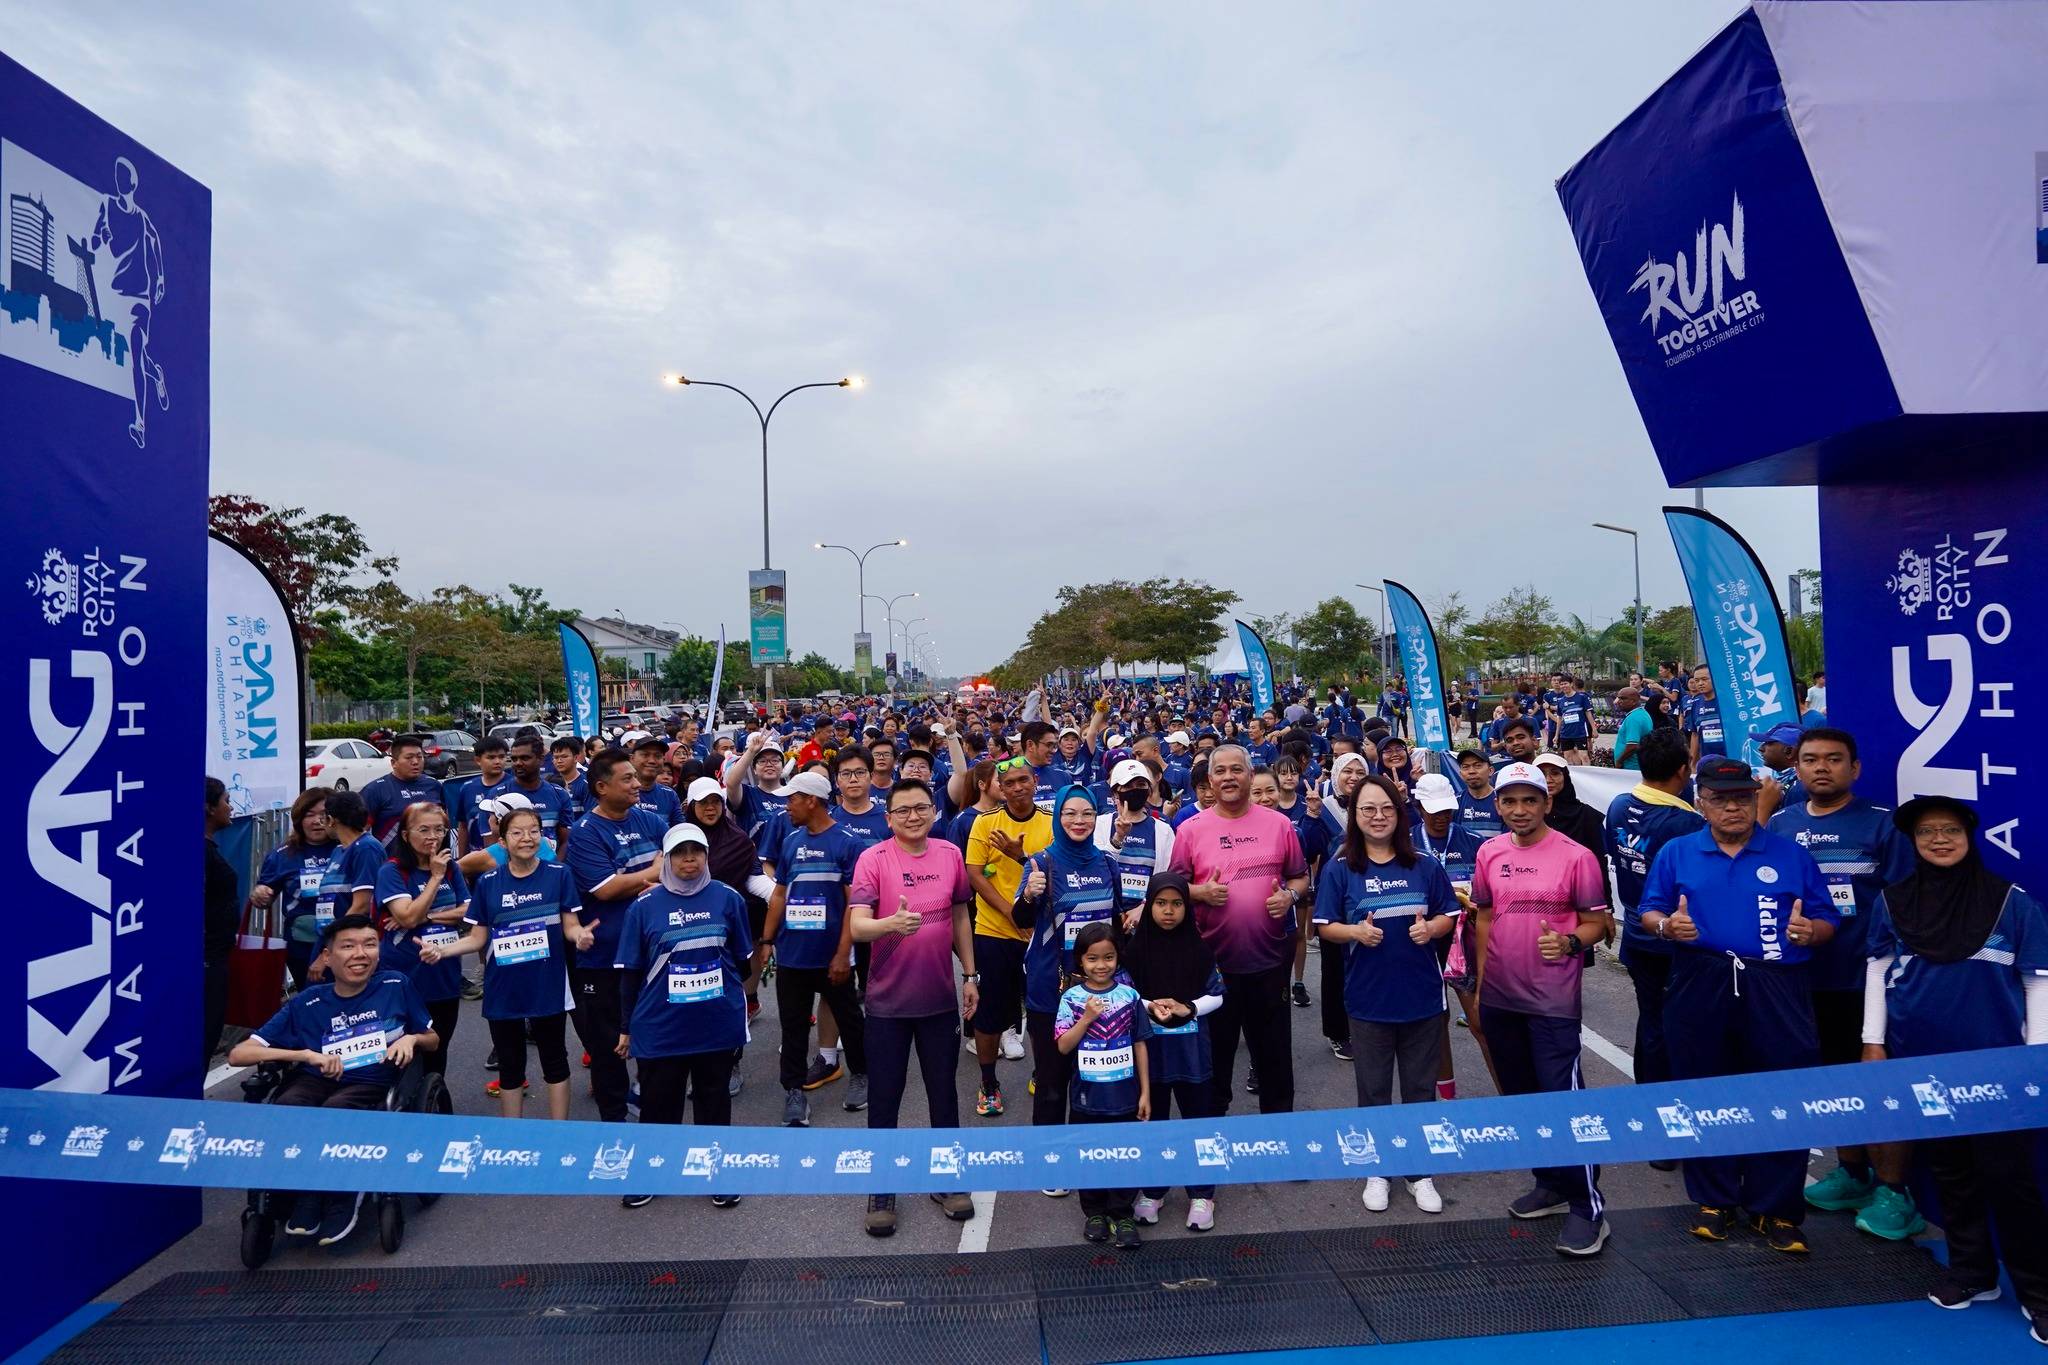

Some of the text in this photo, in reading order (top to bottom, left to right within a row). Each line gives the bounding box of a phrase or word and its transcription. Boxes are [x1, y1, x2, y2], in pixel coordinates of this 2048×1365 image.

[1627, 187, 1745, 336] RUN
[1665, 312, 1765, 368] TOWARDS A SUSTAINABLE CITY
[1935, 533, 1953, 620] ROYAL
[1954, 546, 1971, 608] CITY
[82, 546, 100, 636] ROYAL
[100, 562, 116, 627] CITY
[1973, 528, 2021, 860] ATHON
[114, 554, 148, 1087] MARATHON
[27, 650, 113, 1094] KLANG
[1122, 878, 1147, 887] 10793
[1832, 891, 1849, 900] 46
[788, 909, 823, 917] FR 10042
[1069, 927, 1081, 935] FR
[1758, 895, 1783, 961] MCPF
[498, 936, 544, 951] FR 11225
[673, 975, 719, 988] FR 11199
[346, 1038, 381, 1053] 11228
[1082, 1052, 1131, 1066] FR 10033
[1950, 1083, 1996, 1099] KLANG
[1802, 1097, 1865, 1114] MONZO
[1695, 1108, 1743, 1122] KLANG
[1460, 1126, 1508, 1140] KLANG
[204, 1137, 256, 1151] KLANG
[321, 1143, 388, 1160] MONZO
[1232, 1140, 1278, 1153] KLANG
[481, 1148, 532, 1163] KLANG
[722, 1153, 770, 1165] KLANG
[968, 1151, 1014, 1162] KLANG
[1079, 1147, 1141, 1160] MONZO
